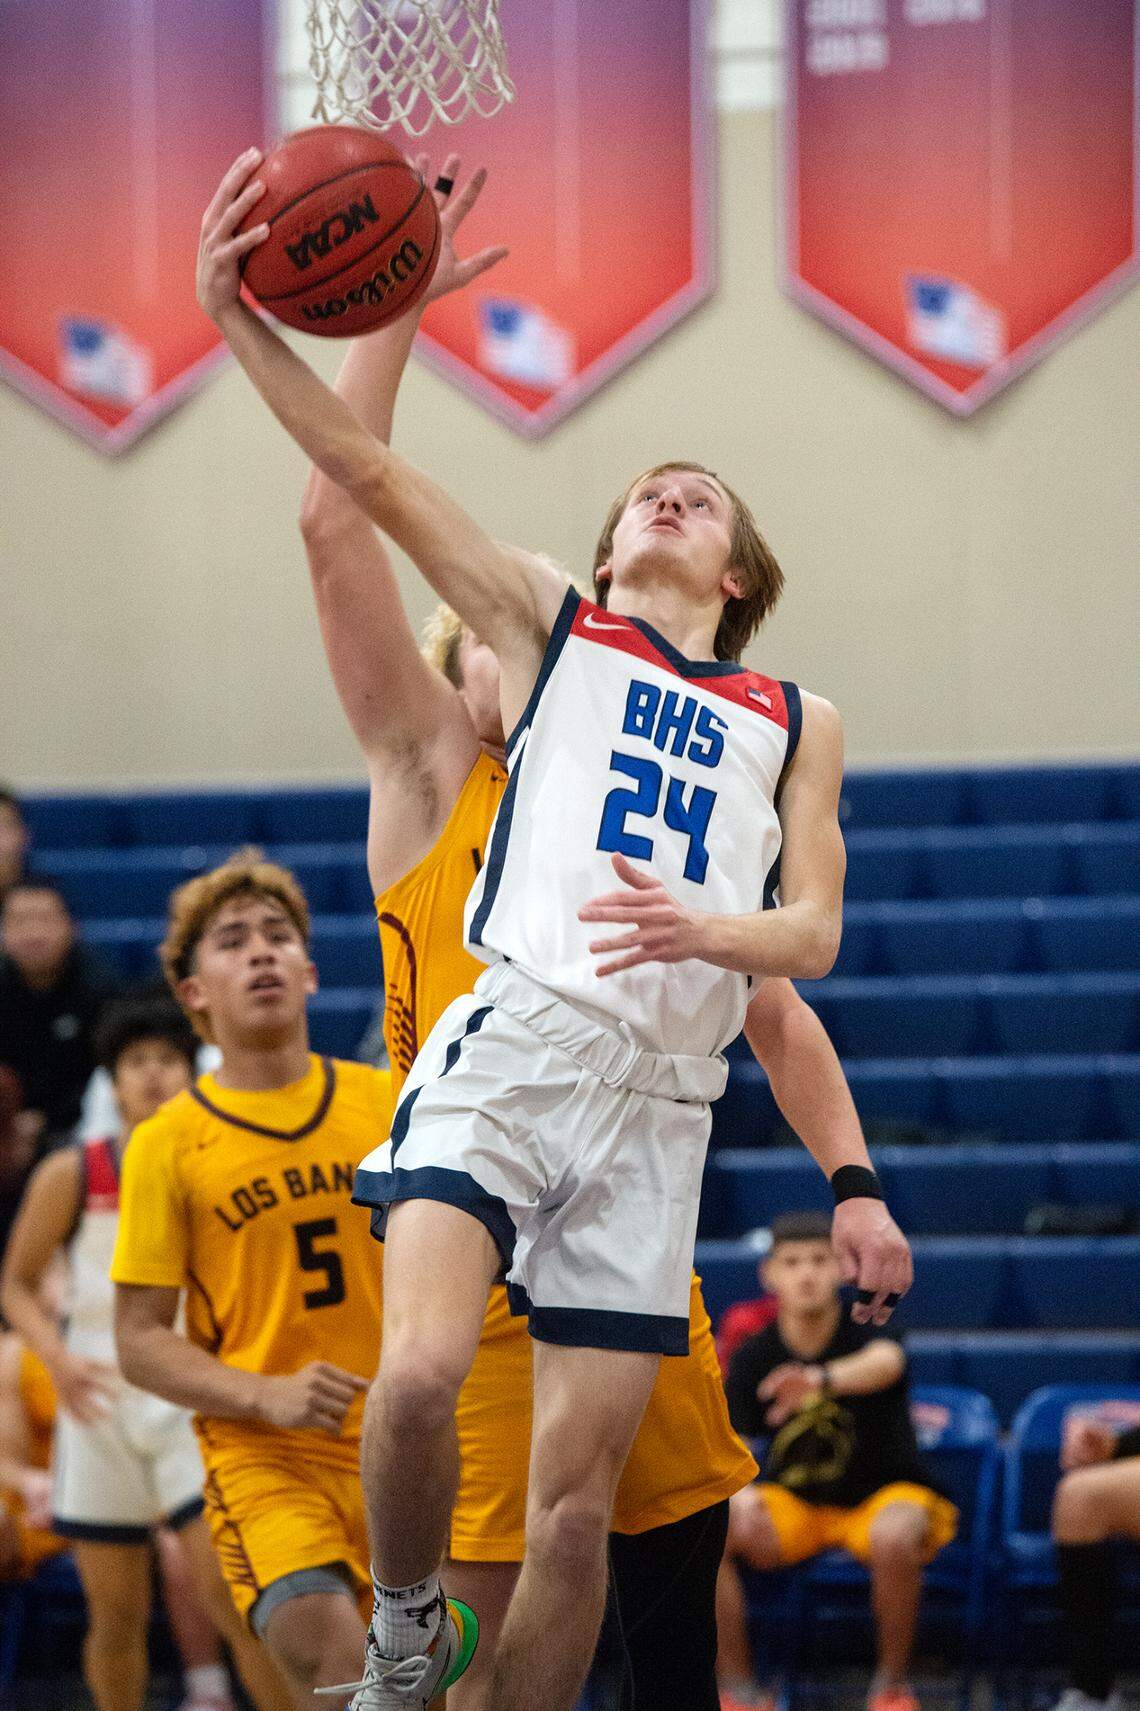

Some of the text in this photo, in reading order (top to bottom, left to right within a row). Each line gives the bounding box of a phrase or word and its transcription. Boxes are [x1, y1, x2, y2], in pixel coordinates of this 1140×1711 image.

[284, 194, 380, 271] NCAA
[301, 240, 422, 321] Wilson
[622, 679, 729, 769] BHS
[596, 750, 718, 885] 24
[214, 1176, 279, 1232] LOS
[294, 1217, 347, 1310] 5
